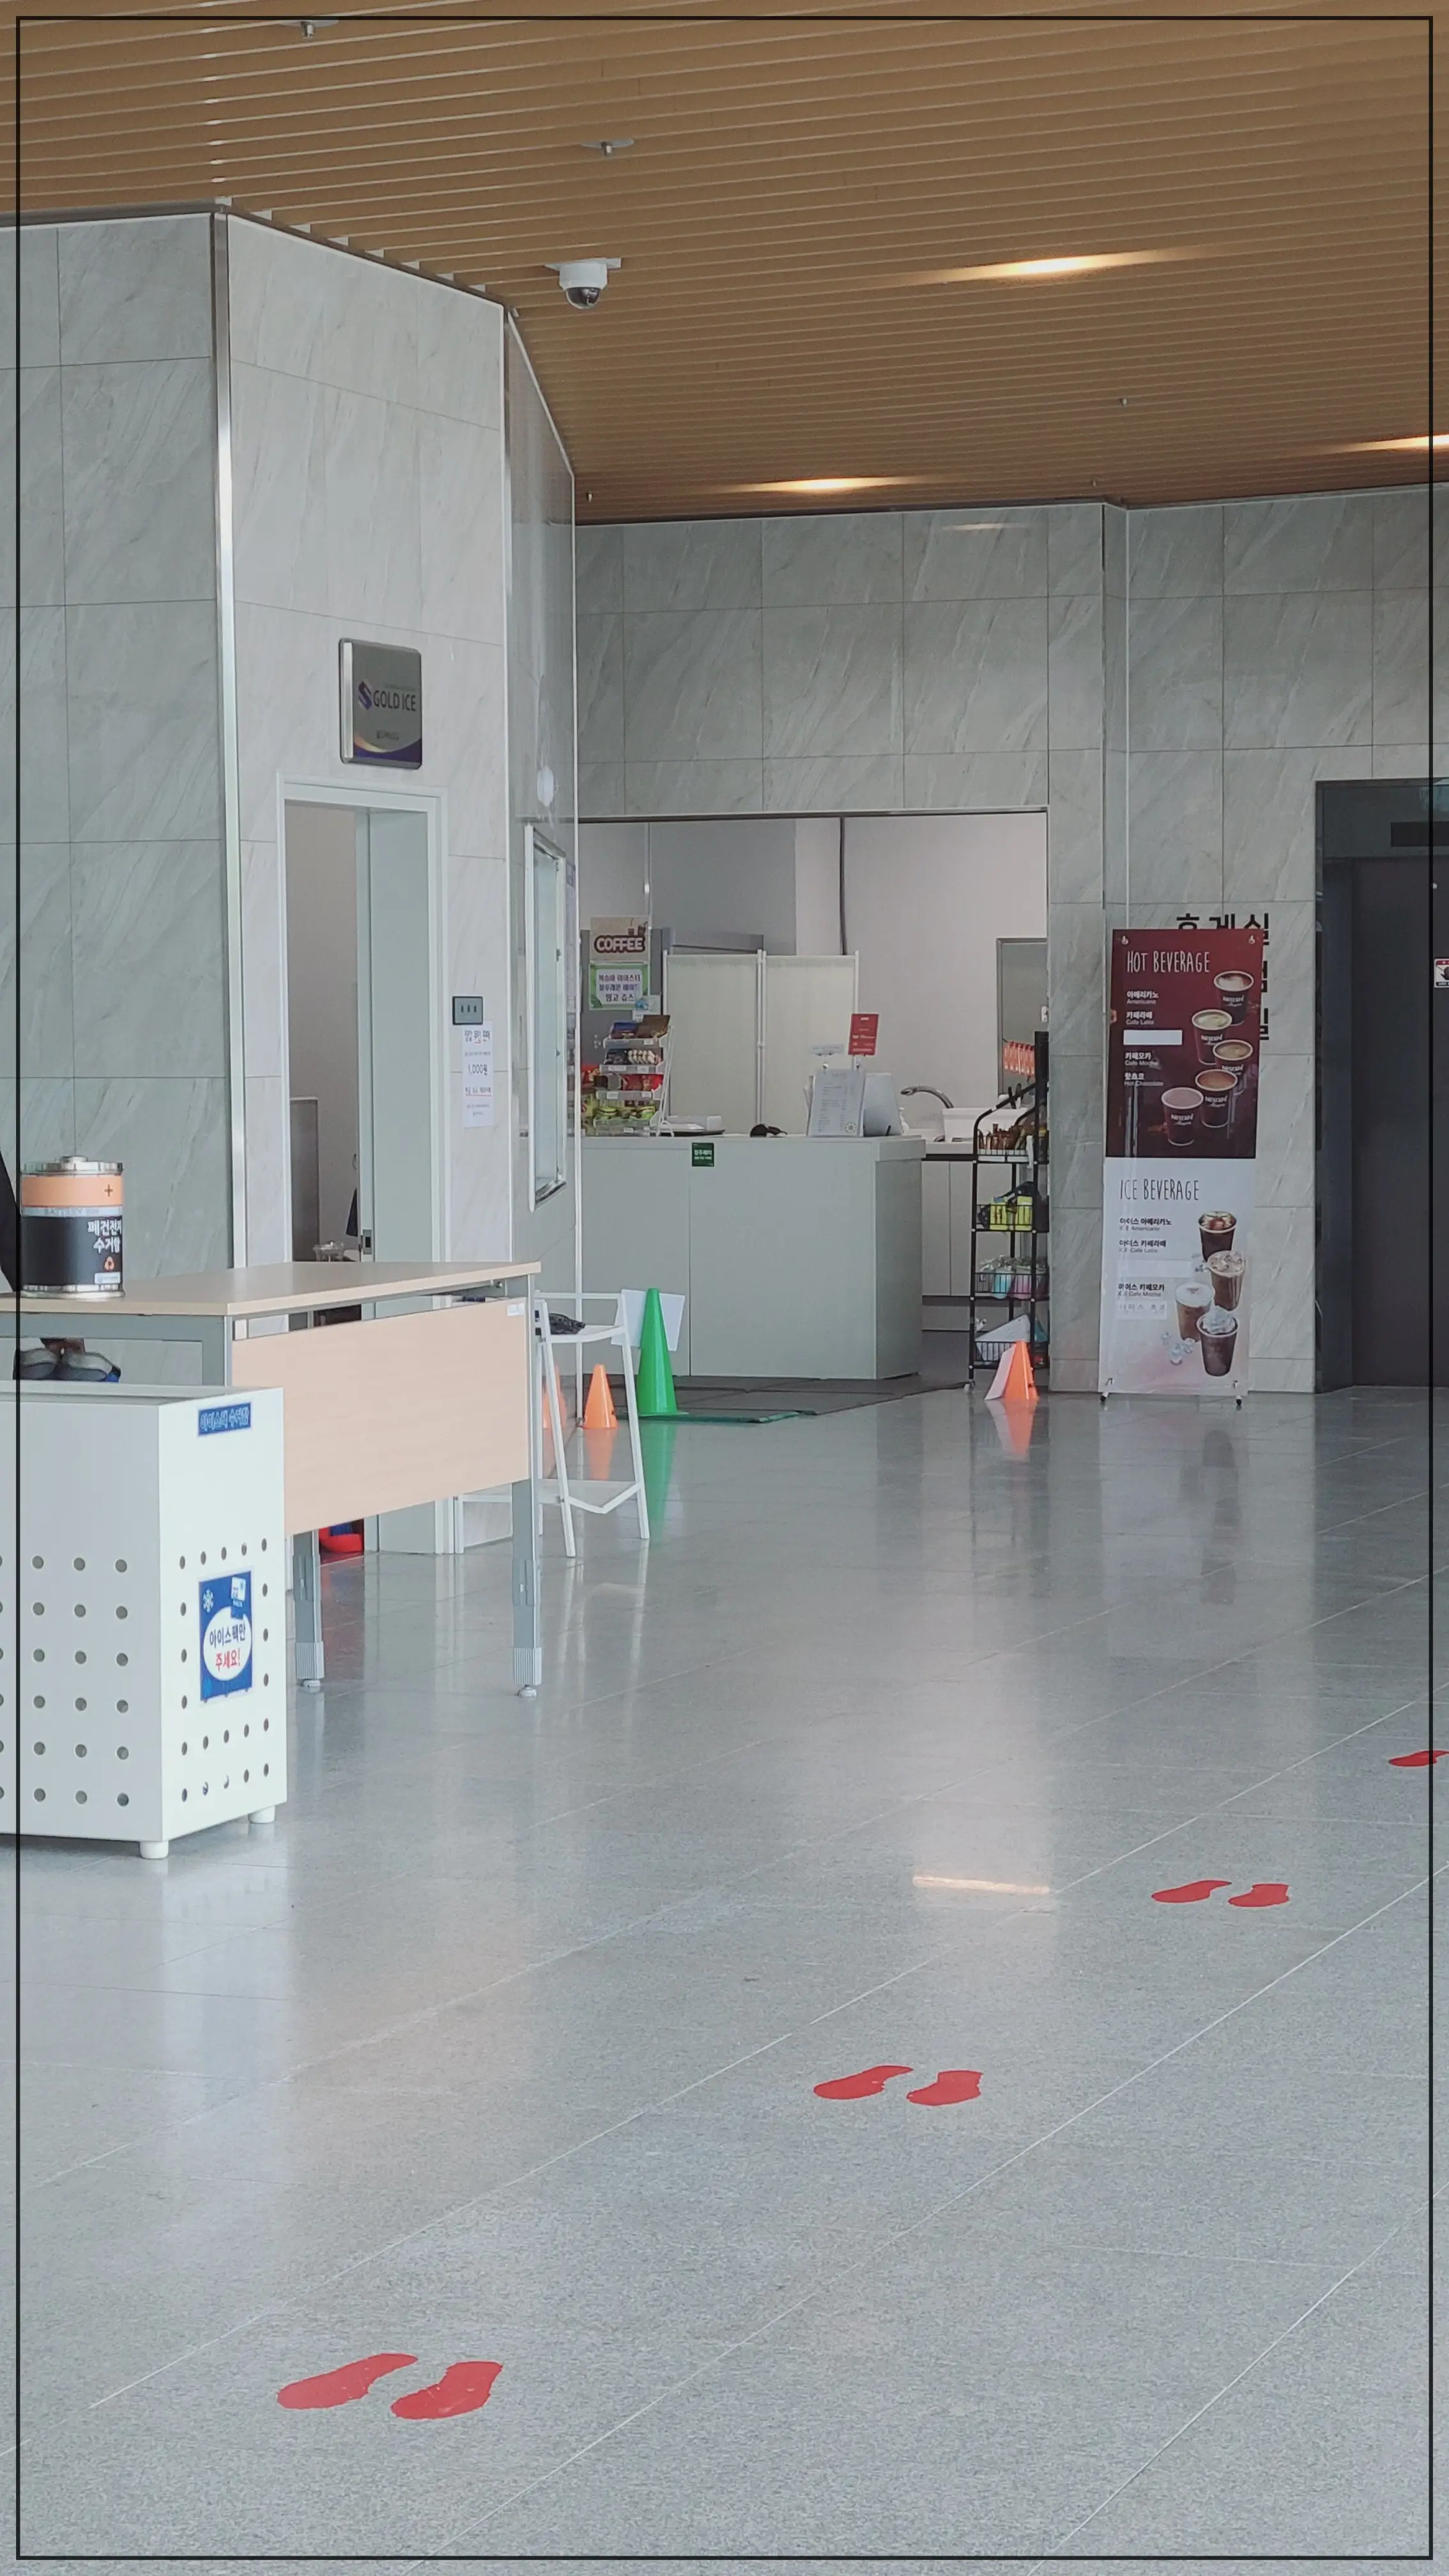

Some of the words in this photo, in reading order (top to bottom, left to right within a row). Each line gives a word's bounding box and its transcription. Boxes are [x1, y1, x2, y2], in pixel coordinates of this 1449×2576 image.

[372, 690, 400, 709] GOLD
[401, 693, 417, 712] ICE
[595, 936, 644, 952] COFFEE
[1126, 950, 1149, 973] HOT
[1153, 950, 1211, 972] BEVERAGE
[606, 993, 619, 1002] 망고
[621, 993, 635, 1002] 쥬스
[1119, 1179, 1138, 1200] ICE
[1143, 1178, 1199, 1201] BEVERAGE
[93, 1236, 121, 1254] 수거함
[209, 1623, 246, 1649] 아이스팩만
[215, 1648, 241, 1672] 주세요!
